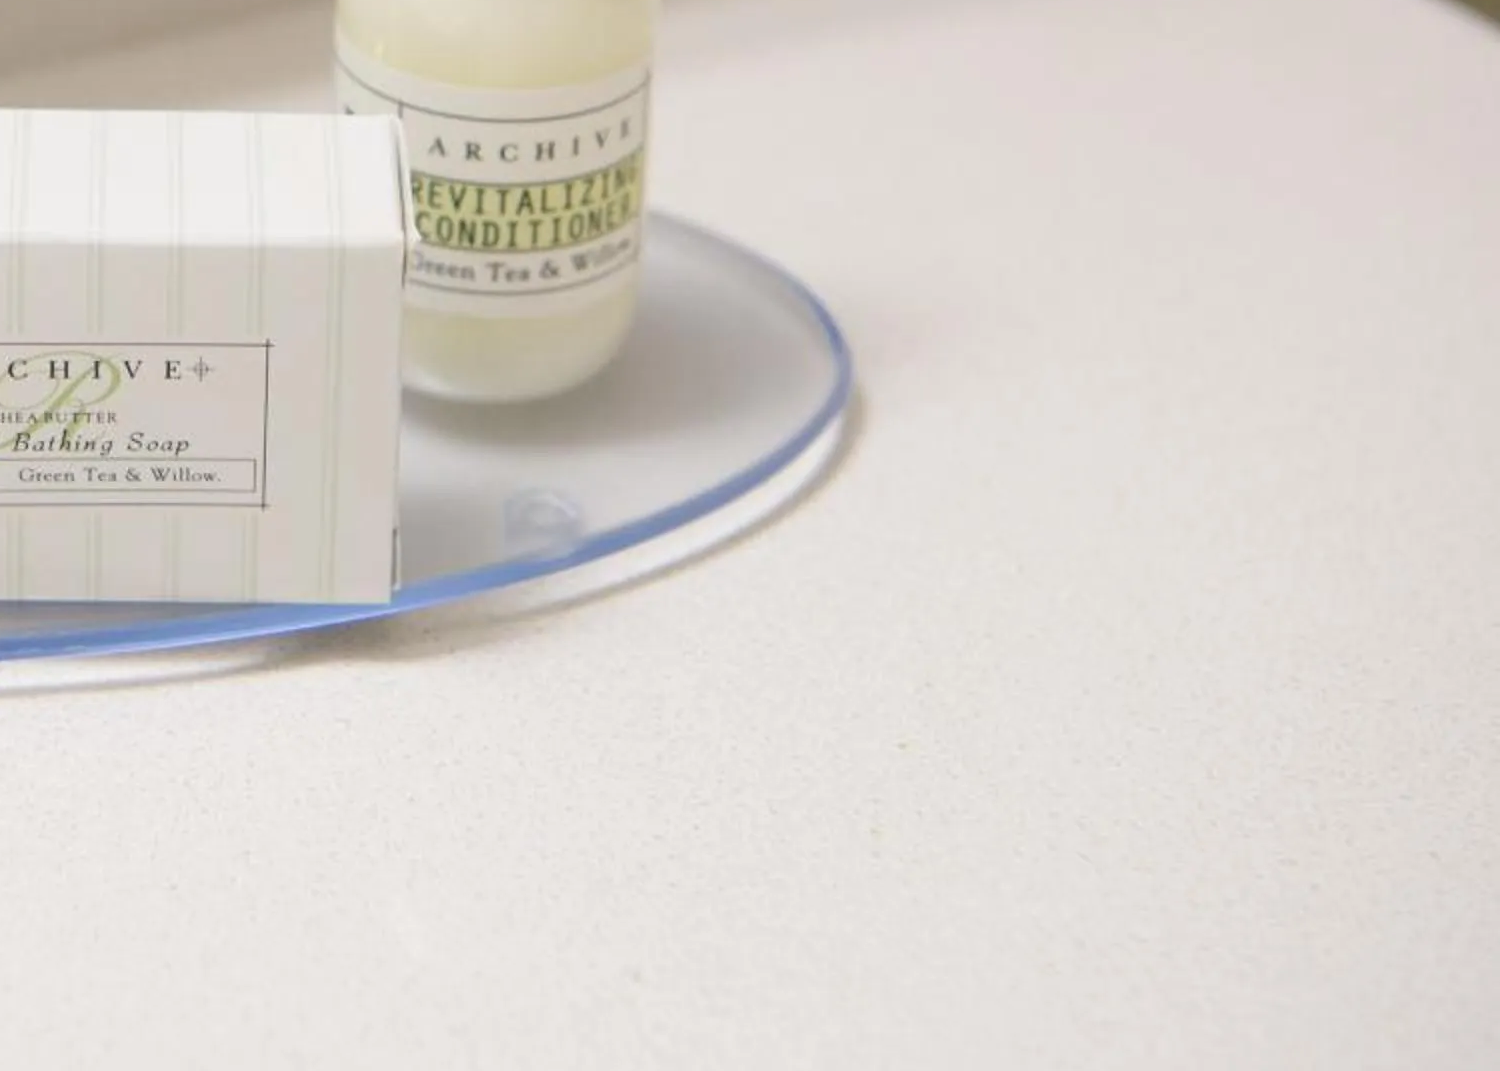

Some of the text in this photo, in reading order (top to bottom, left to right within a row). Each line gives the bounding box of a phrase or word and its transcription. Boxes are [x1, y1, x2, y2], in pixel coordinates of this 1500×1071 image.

[43, 411, 117, 424] BUTTER
[12, 429, 114, 455] Bathing
[126, 432, 190, 456] Soap
[18, 466, 222, 483] Green Tea & Willow.
